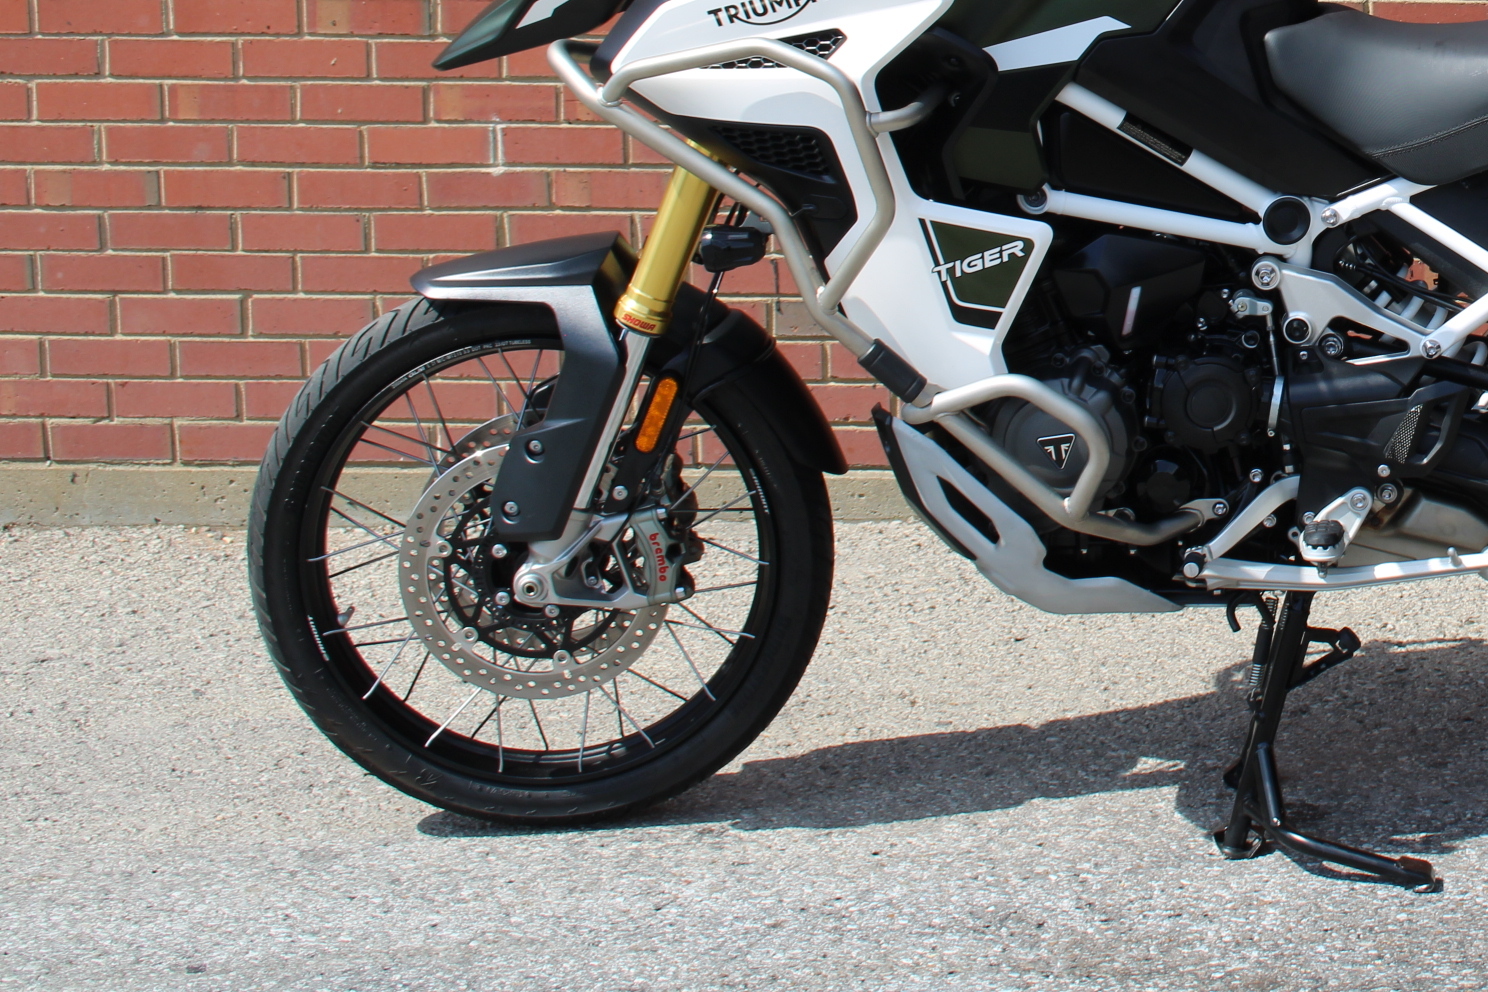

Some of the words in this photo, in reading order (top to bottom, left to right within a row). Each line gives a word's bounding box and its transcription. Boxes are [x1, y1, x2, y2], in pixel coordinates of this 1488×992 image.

[931, 240, 1026, 282] TIGER
[622, 313, 657, 331] SHOWA
[648, 532, 667, 582] brembo
